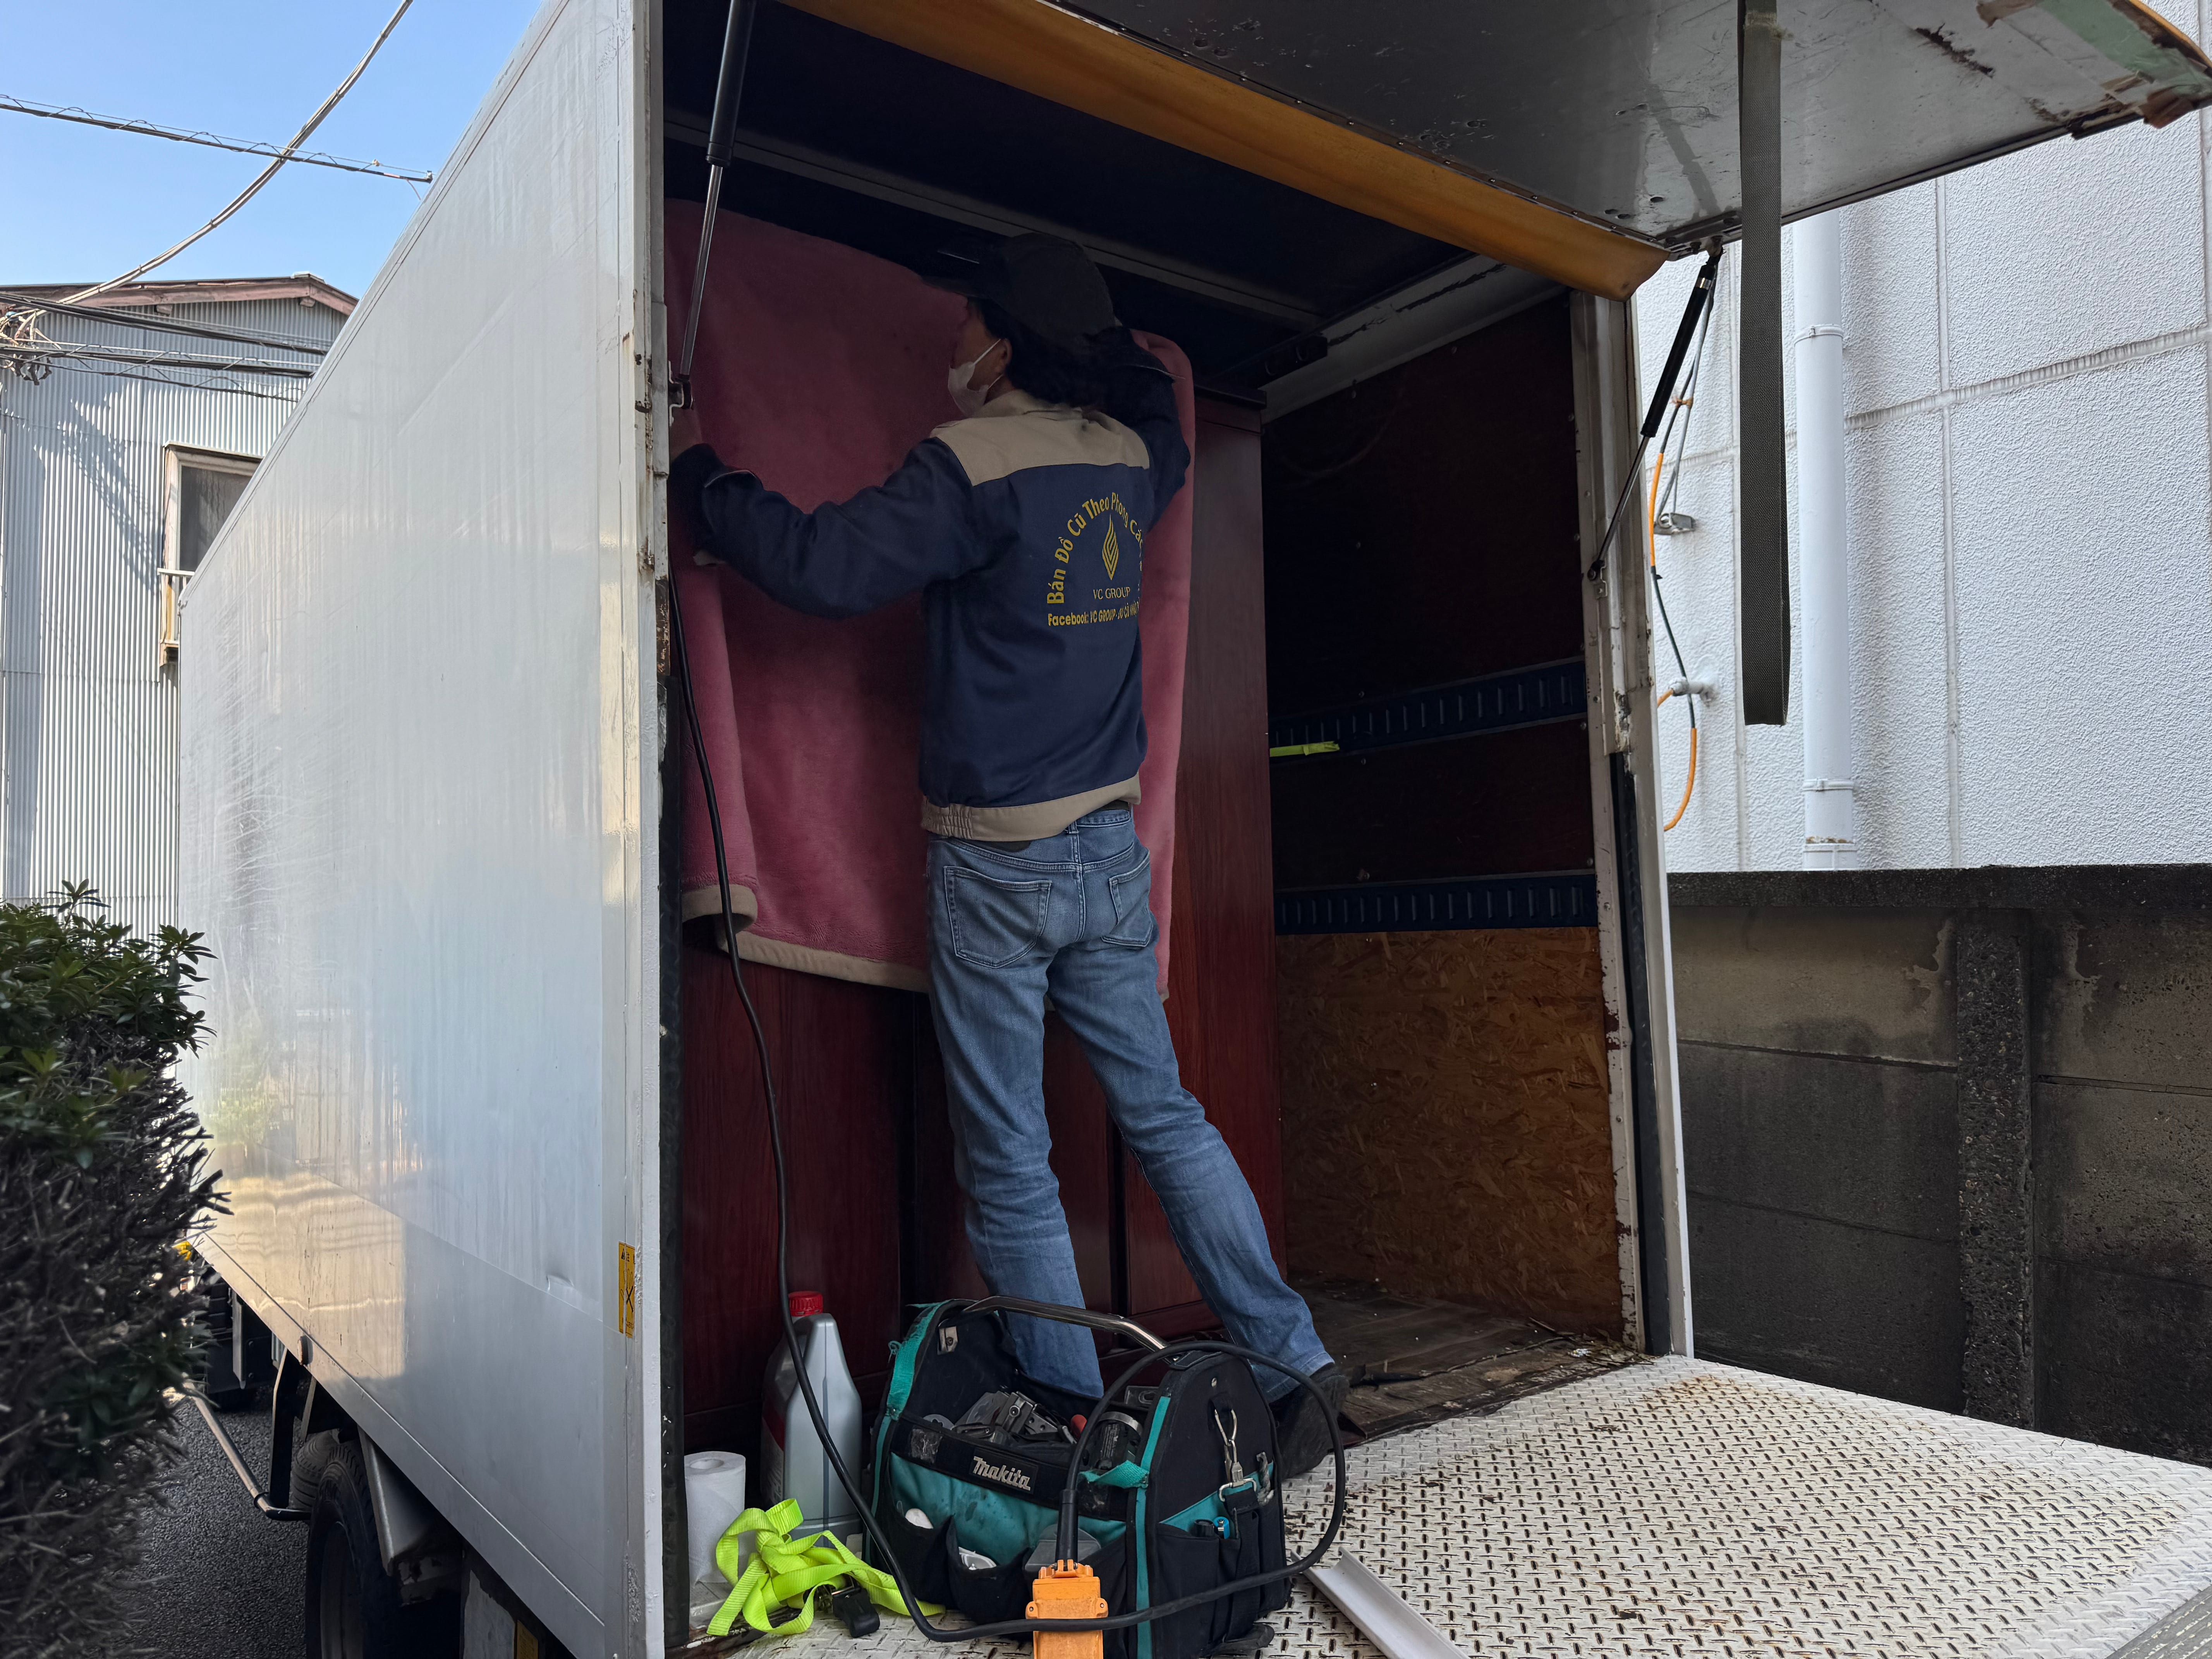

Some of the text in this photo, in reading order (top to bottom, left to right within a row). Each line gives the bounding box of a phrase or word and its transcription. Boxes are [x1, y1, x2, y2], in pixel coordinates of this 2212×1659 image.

[1082, 497, 1109, 519] Theo
[1111, 492, 1128, 528] Phong
[1067, 512, 1087, 536] Cũ
[1054, 536, 1073, 563] Đồ
[1047, 568, 1066, 604] Bán
[1093, 588, 1103, 599] VC
[1105, 586, 1130, 599] GROUP
[1048, 611, 1089, 626] Facebook:
[1090, 610, 1097, 623] VC
[1098, 608, 1116, 622] GROUP
[972, 1456, 1031, 1491] Makita
